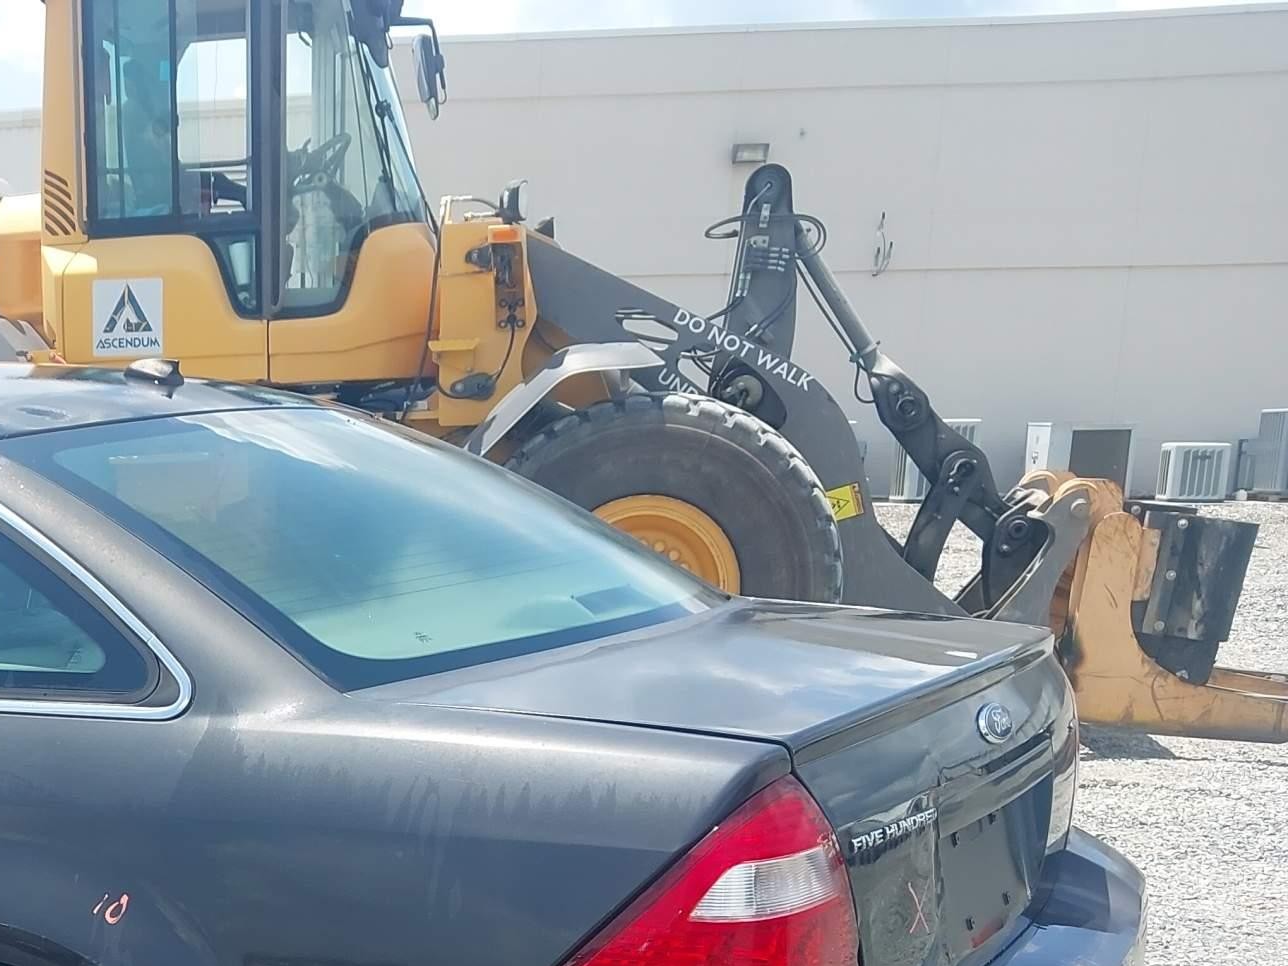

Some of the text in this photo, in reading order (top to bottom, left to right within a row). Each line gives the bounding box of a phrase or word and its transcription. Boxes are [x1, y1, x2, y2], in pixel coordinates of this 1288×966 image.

[96, 336, 161, 349] ASCENDUM
[674, 308, 815, 392] DO NOT WALK
[852, 828, 884, 854] FIVE
